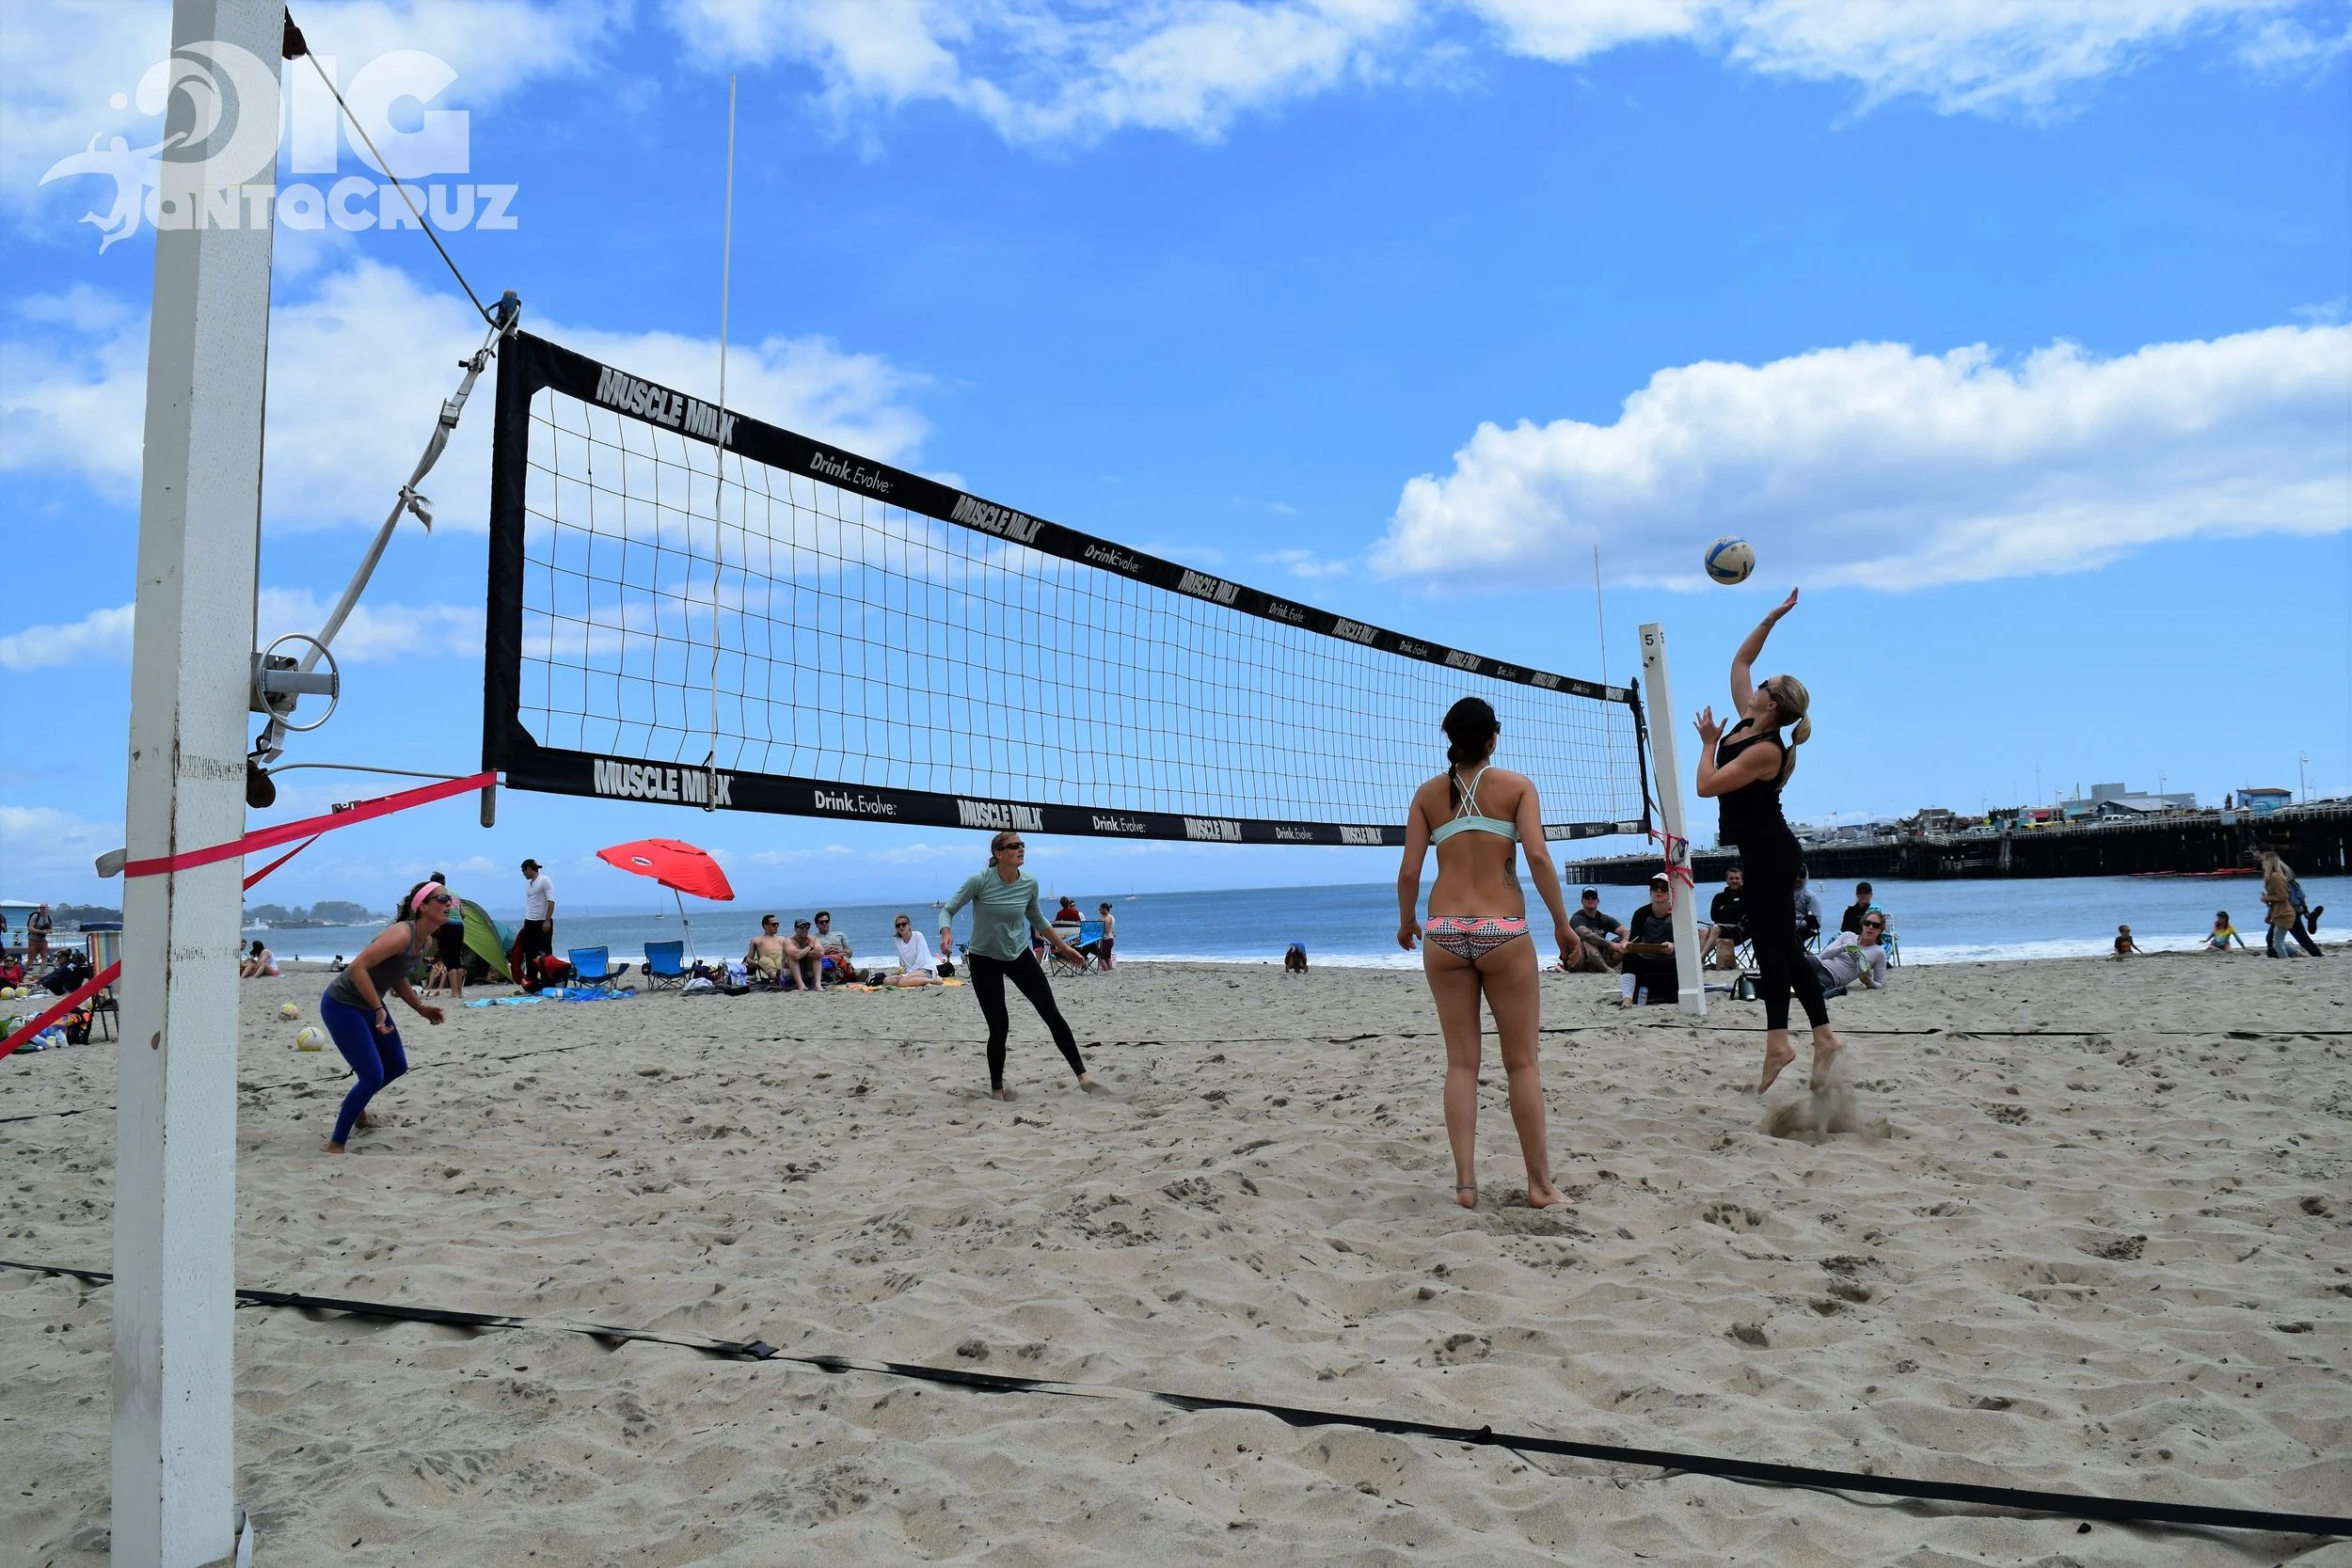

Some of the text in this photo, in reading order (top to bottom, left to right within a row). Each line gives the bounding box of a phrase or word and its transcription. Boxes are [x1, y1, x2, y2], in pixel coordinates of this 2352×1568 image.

[595, 366, 736, 446] MUSCLE MILK
[810, 451, 851, 482] Drink.
[950, 494, 1042, 544] MUSCLE MILK
[1178, 569, 1240, 604] MUSCLE MILK
[1331, 618, 1363, 641] MUSCLE
[1645, 633, 1654, 645] 5
[594, 758, 733, 805] MUSCLE MIK
[814, 790, 857, 813] Drink.
[957, 799, 1043, 831] MUSCLE MILK
[1092, 816, 1120, 832] Drink.
[1184, 816, 1242, 841] MUSCLE MILK
[1340, 826, 1383, 845] MUSCLE MILK
